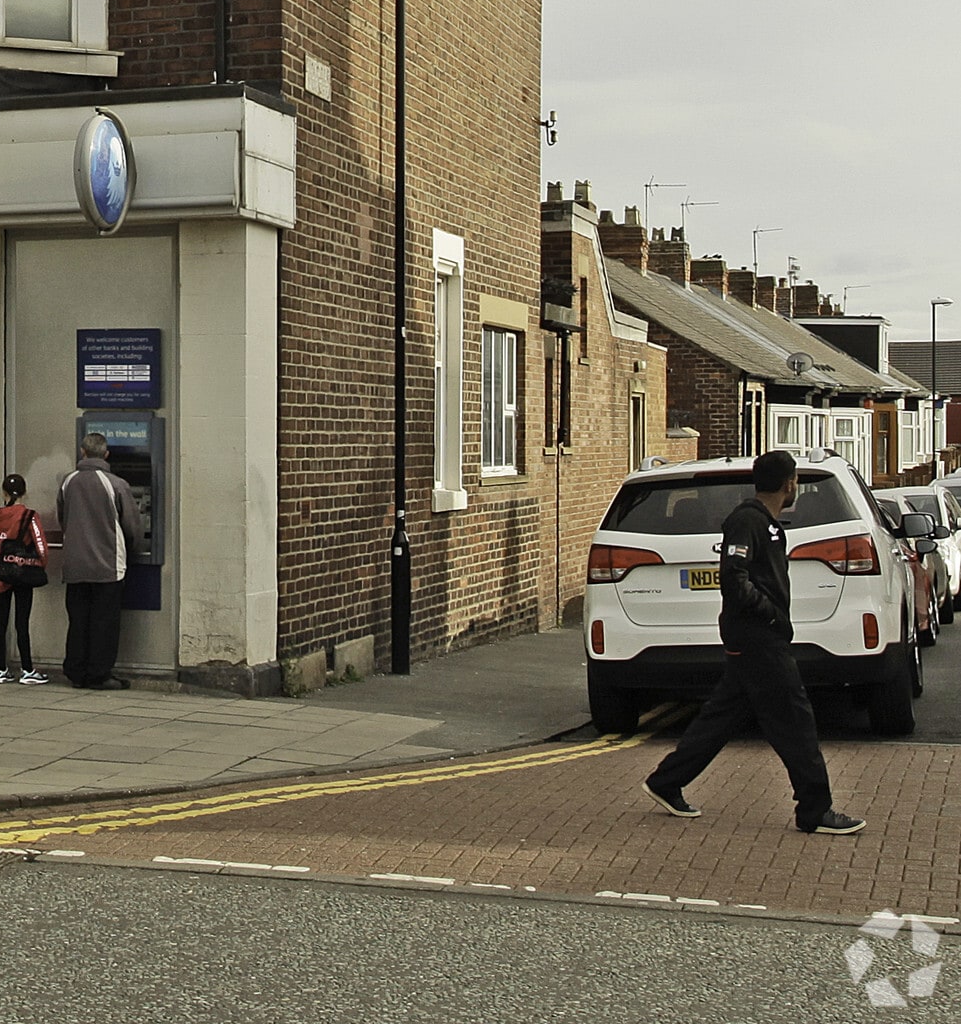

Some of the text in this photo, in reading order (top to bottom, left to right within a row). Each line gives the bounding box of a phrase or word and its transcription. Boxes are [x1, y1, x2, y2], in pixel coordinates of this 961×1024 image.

[106, 430, 114, 438] in
[115, 430, 128, 438] the
[129, 430, 147, 438] wall
